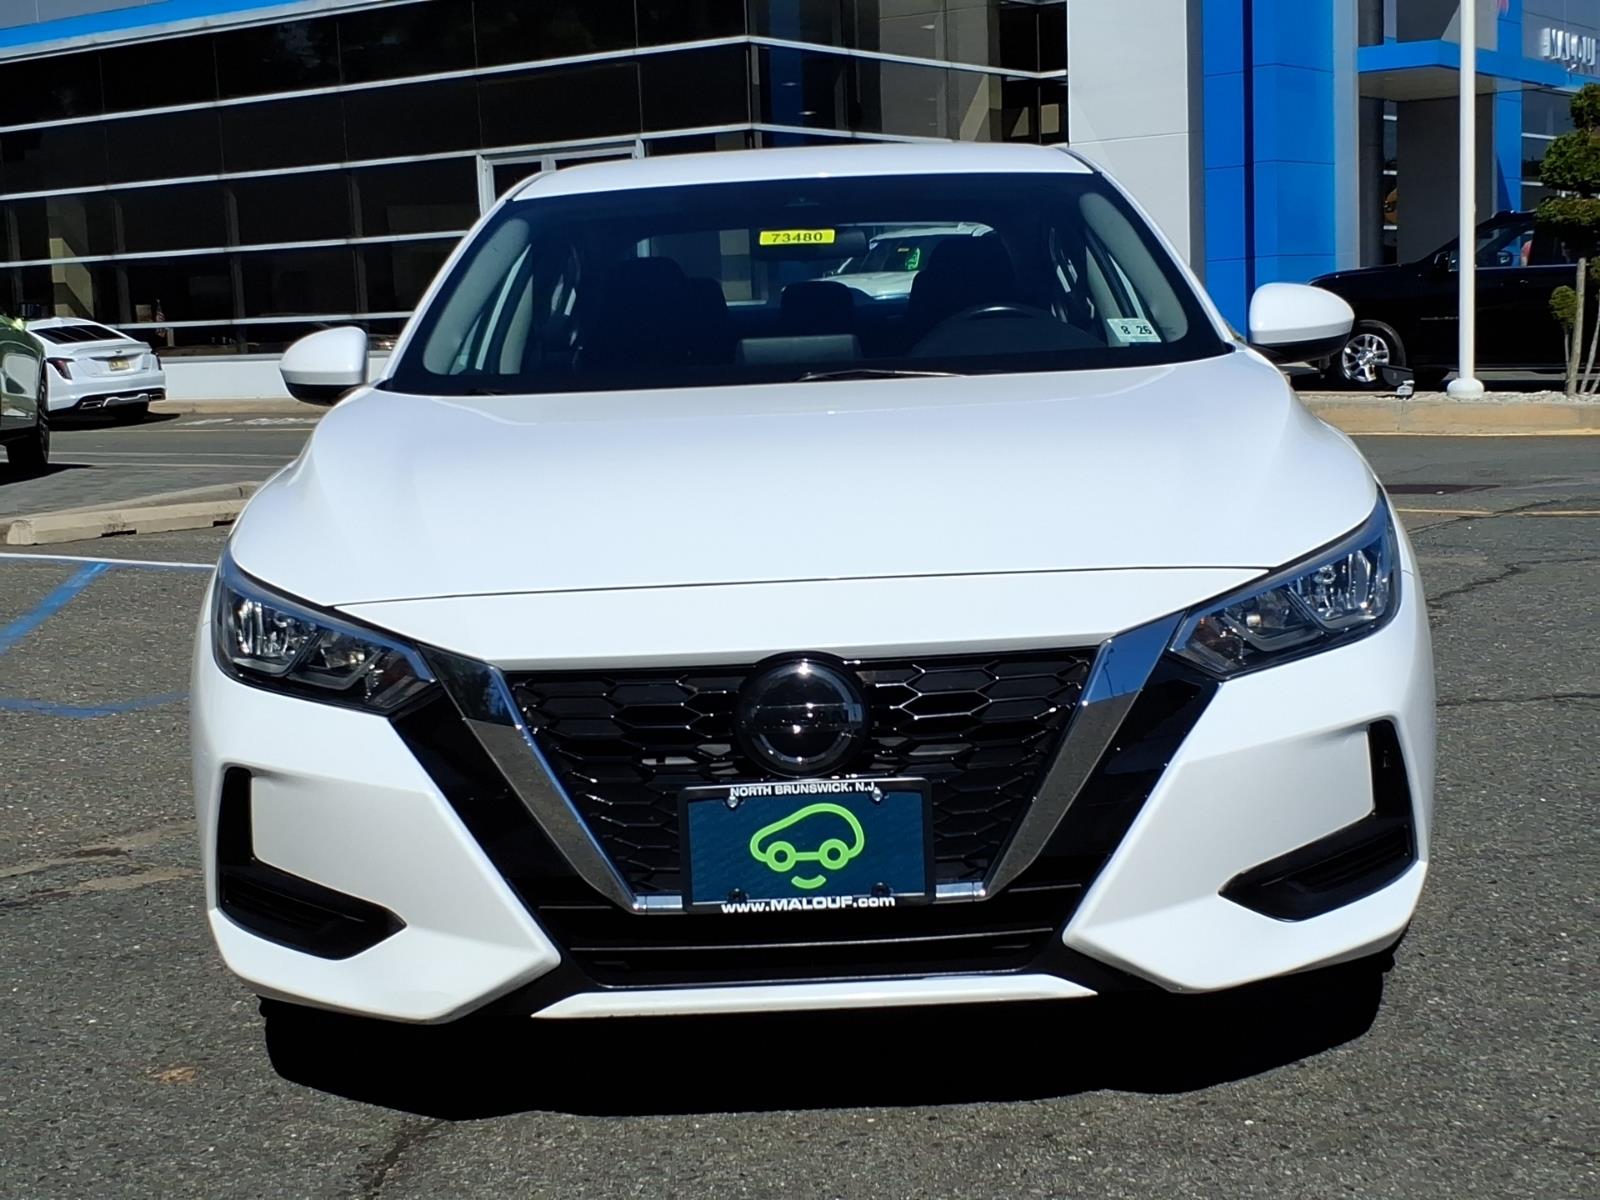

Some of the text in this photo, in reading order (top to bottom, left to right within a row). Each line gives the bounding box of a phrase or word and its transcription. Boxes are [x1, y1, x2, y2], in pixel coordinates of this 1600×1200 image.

[771, 231, 823, 243] 73480
[1136, 325, 1153, 335] 26
[730, 785, 772, 797] NORTH
[720, 895, 896, 914] www.MALOUF.com
